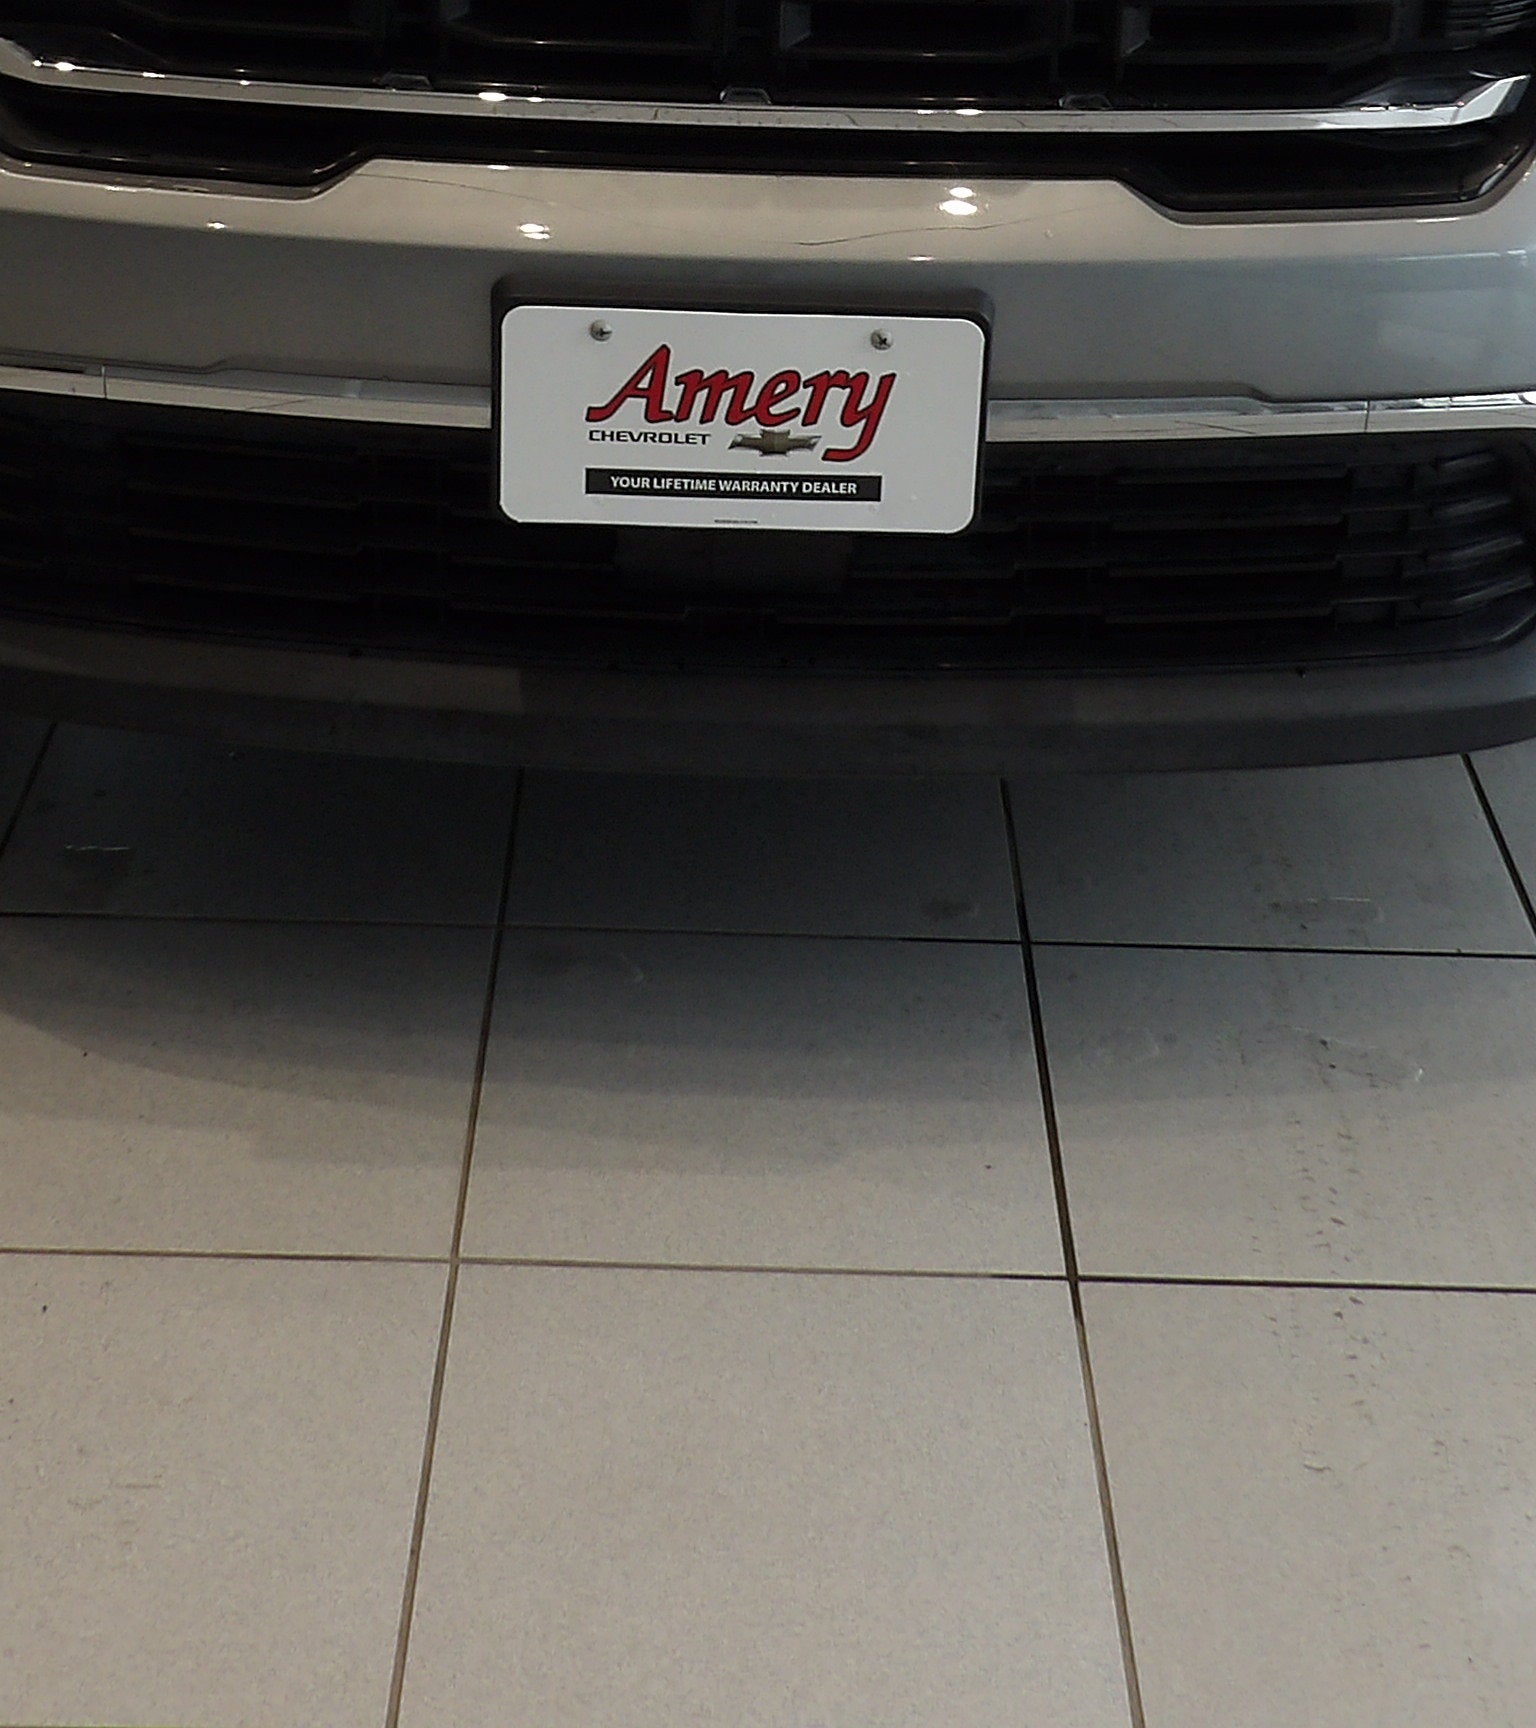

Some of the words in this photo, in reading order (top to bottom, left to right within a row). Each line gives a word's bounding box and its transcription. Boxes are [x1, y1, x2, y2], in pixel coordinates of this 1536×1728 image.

[585, 343, 897, 462] Amery
[588, 428, 712, 446] CHEVROLET
[610, 475, 651, 490] YOUR
[652, 477, 717, 492] LIFETIME
[718, 479, 800, 494] WARRANTY
[801, 481, 858, 495] DEALER
